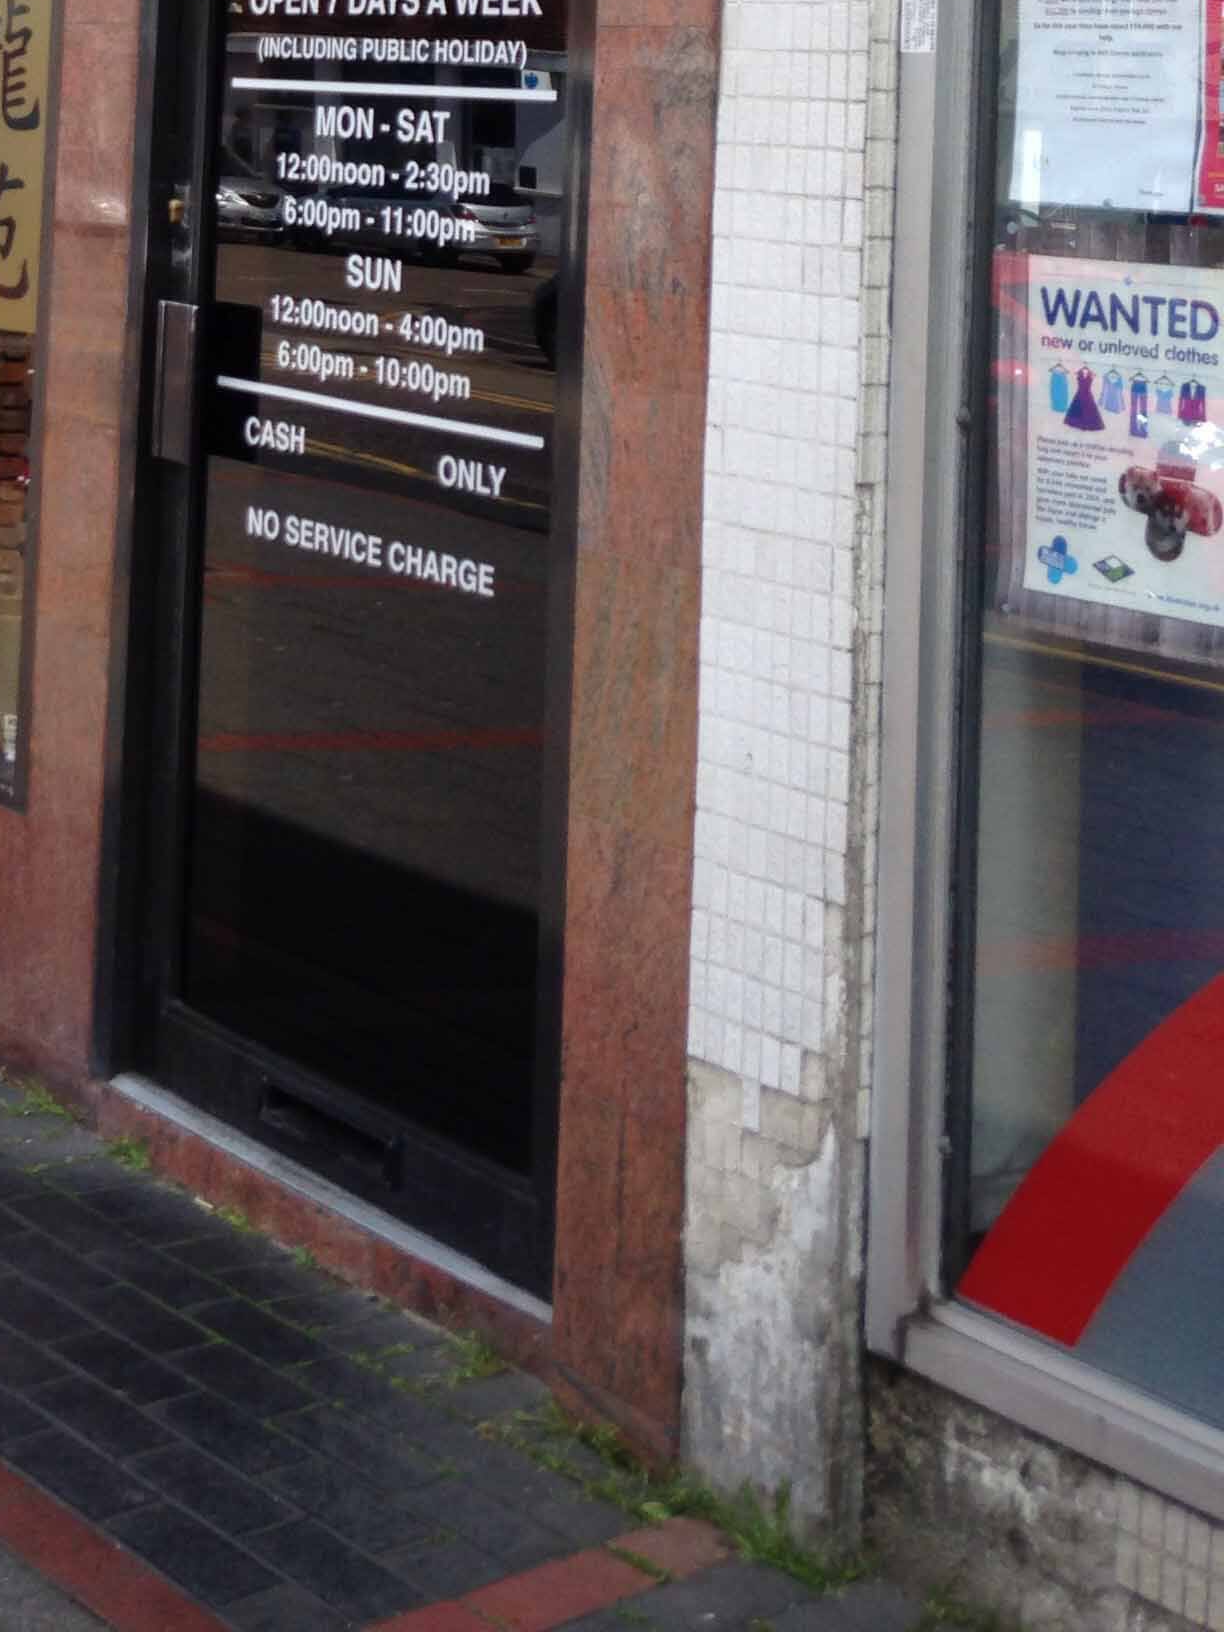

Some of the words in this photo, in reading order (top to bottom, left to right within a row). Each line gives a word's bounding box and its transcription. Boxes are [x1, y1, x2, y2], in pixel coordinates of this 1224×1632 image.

[258, 37, 357, 63] (INCLUDING
[361, 37, 430, 63] PUBLIC
[434, 40, 528, 70] HOLIDAY)
[315, 106, 375, 140] MON
[396, 109, 451, 144] SAT
[276, 152, 386, 187] 12:00noon
[405, 161, 491, 200] 2:30pm
[284, 198, 360, 235] 6:00pm
[381, 205, 477, 247] 11:00pm
[346, 254, 402, 293] SUN
[271, 294, 379, 337] 12:00noon
[399, 313, 485, 355] 4:00pm
[1040, 285, 1219, 342] WANTED
[277, 340, 354, 382] 6:00pm
[375, 356, 472, 401] 10:00pm
[1041, 335, 1073, 350] new
[1078, 338, 1094, 352] or
[1099, 339, 1159, 360] unloved
[1164, 345, 1219, 366] clothes
[245, 416, 306, 454] CASH
[437, 455, 507, 497] ONLY
[246, 506, 280, 541] NO
[285, 515, 382, 567] SERVICE
[387, 542, 496, 598] CHARGE
